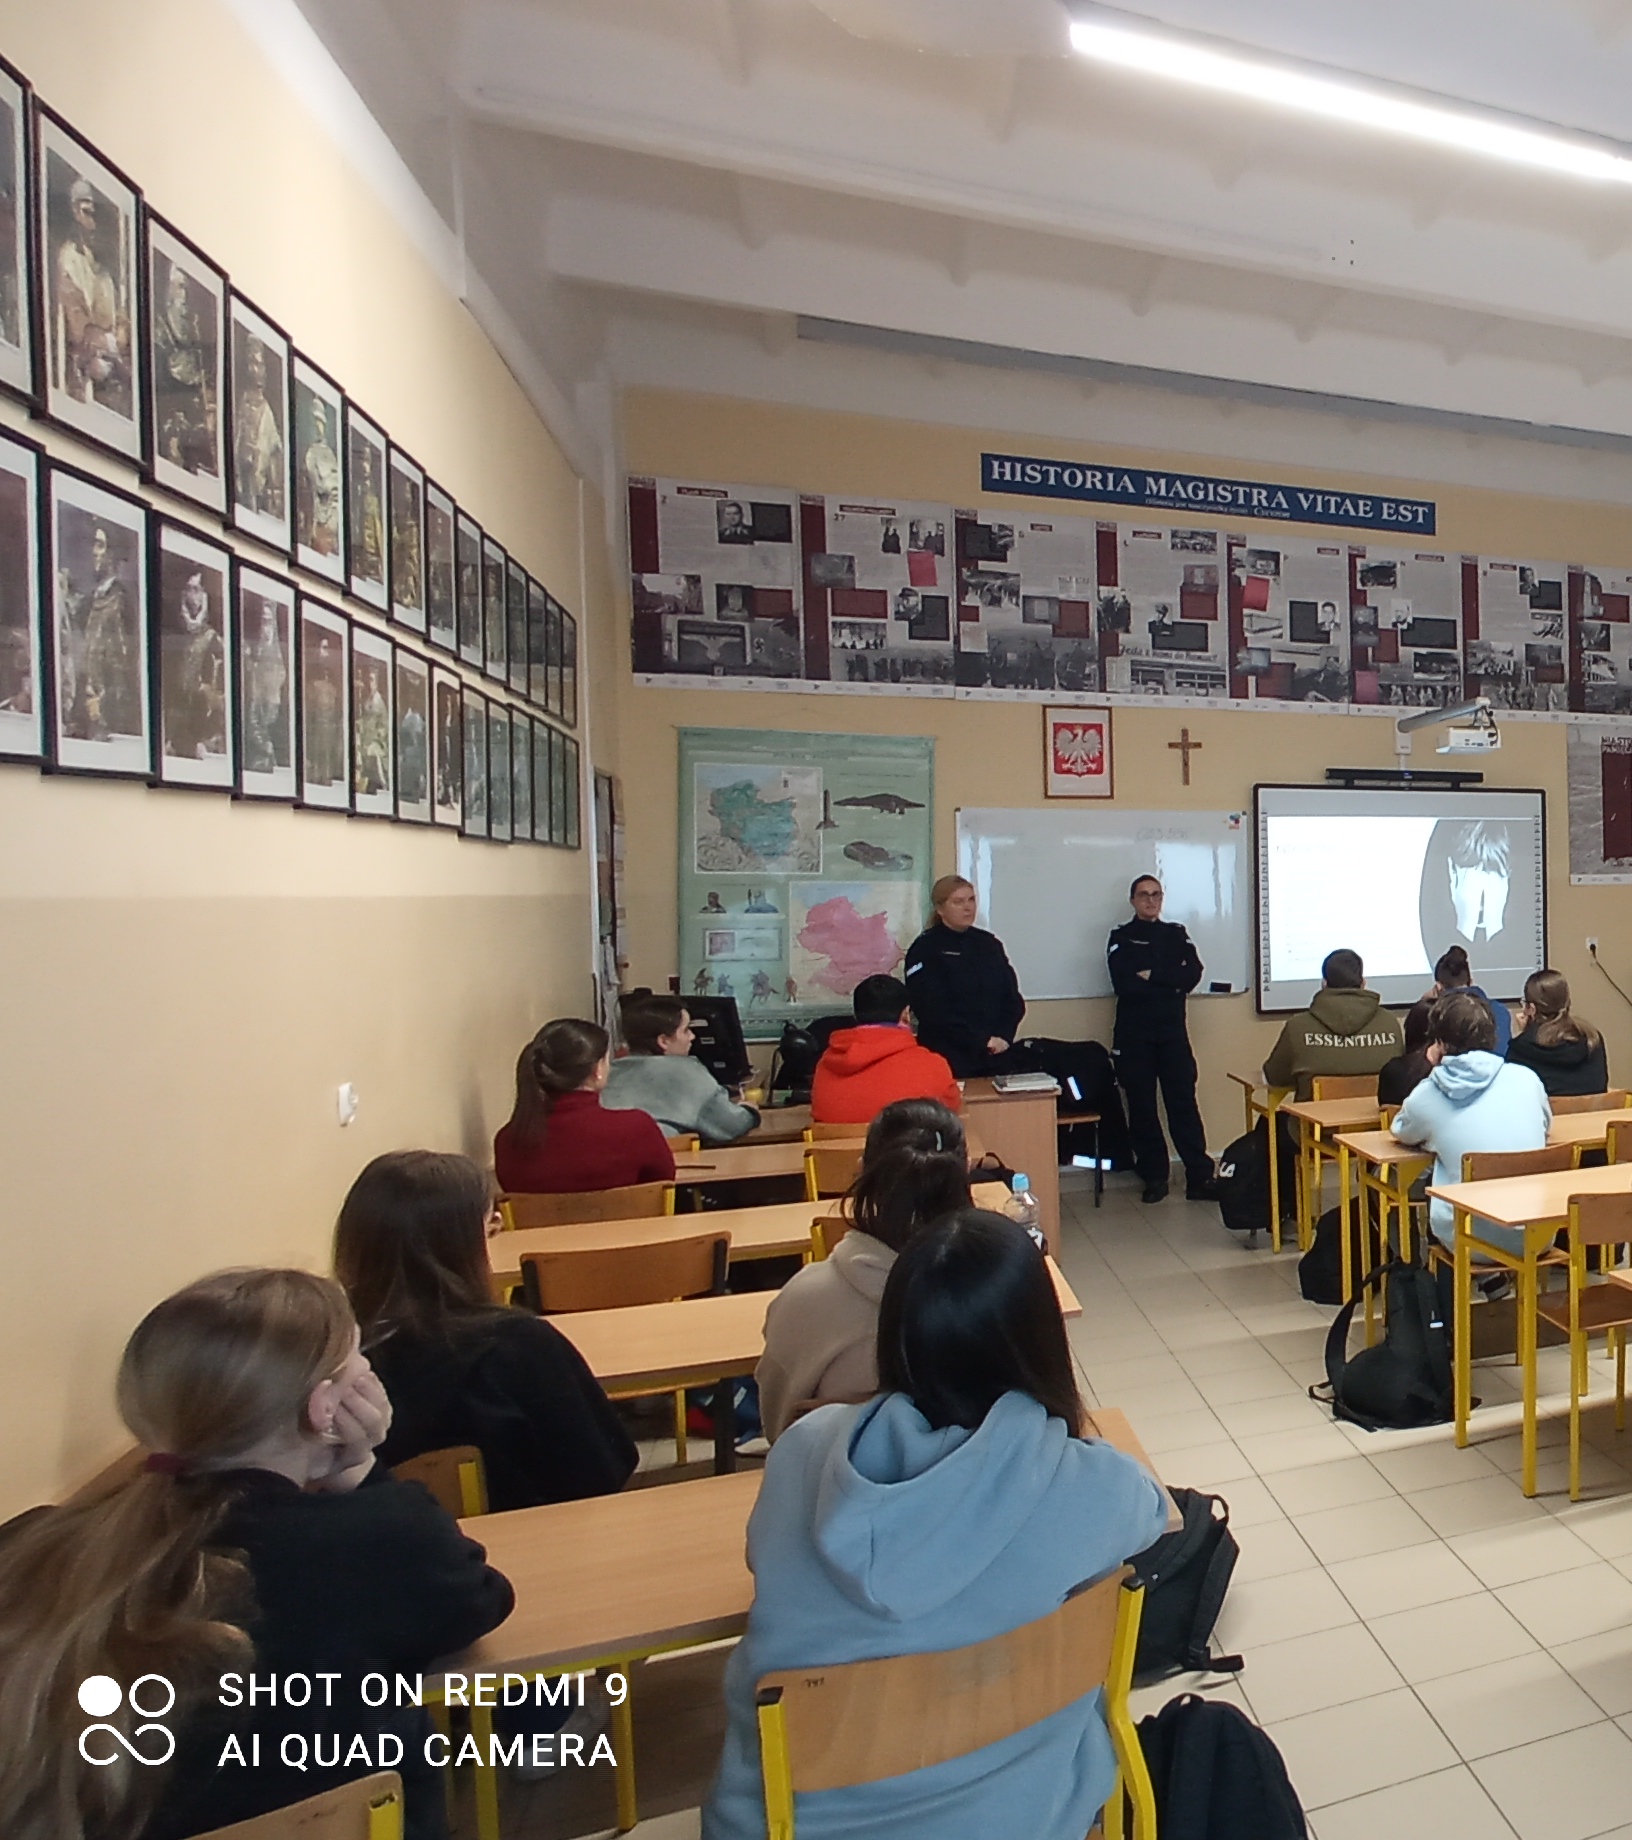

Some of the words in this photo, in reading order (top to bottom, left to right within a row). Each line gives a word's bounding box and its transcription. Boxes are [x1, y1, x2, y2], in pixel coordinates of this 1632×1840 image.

[990, 459, 1136, 494] HISTORIA
[1144, 476, 1290, 509] MAGISTRA
[1297, 492, 1374, 518] VITAE
[1381, 502, 1429, 524] EST
[1304, 1032, 1396, 1048] ESSENTIALS
